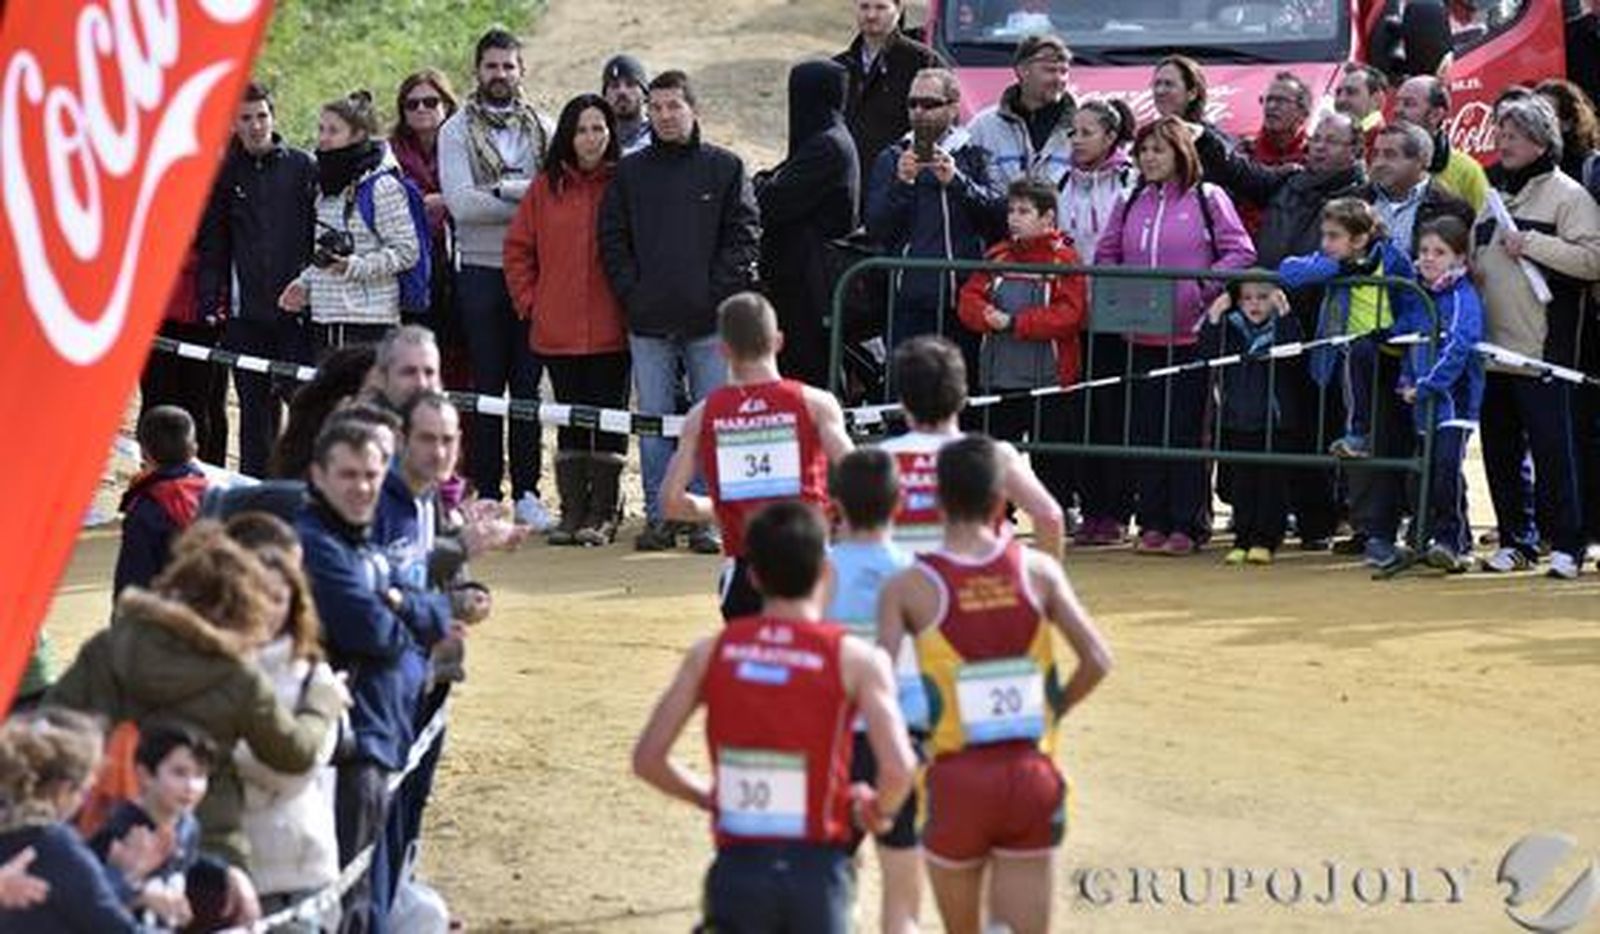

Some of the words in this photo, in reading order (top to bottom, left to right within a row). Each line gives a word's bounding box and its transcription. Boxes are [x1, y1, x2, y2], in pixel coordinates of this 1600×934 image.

[744, 453, 772, 479] 34
[989, 686, 1023, 716] 20
[736, 779, 771, 810] 30
